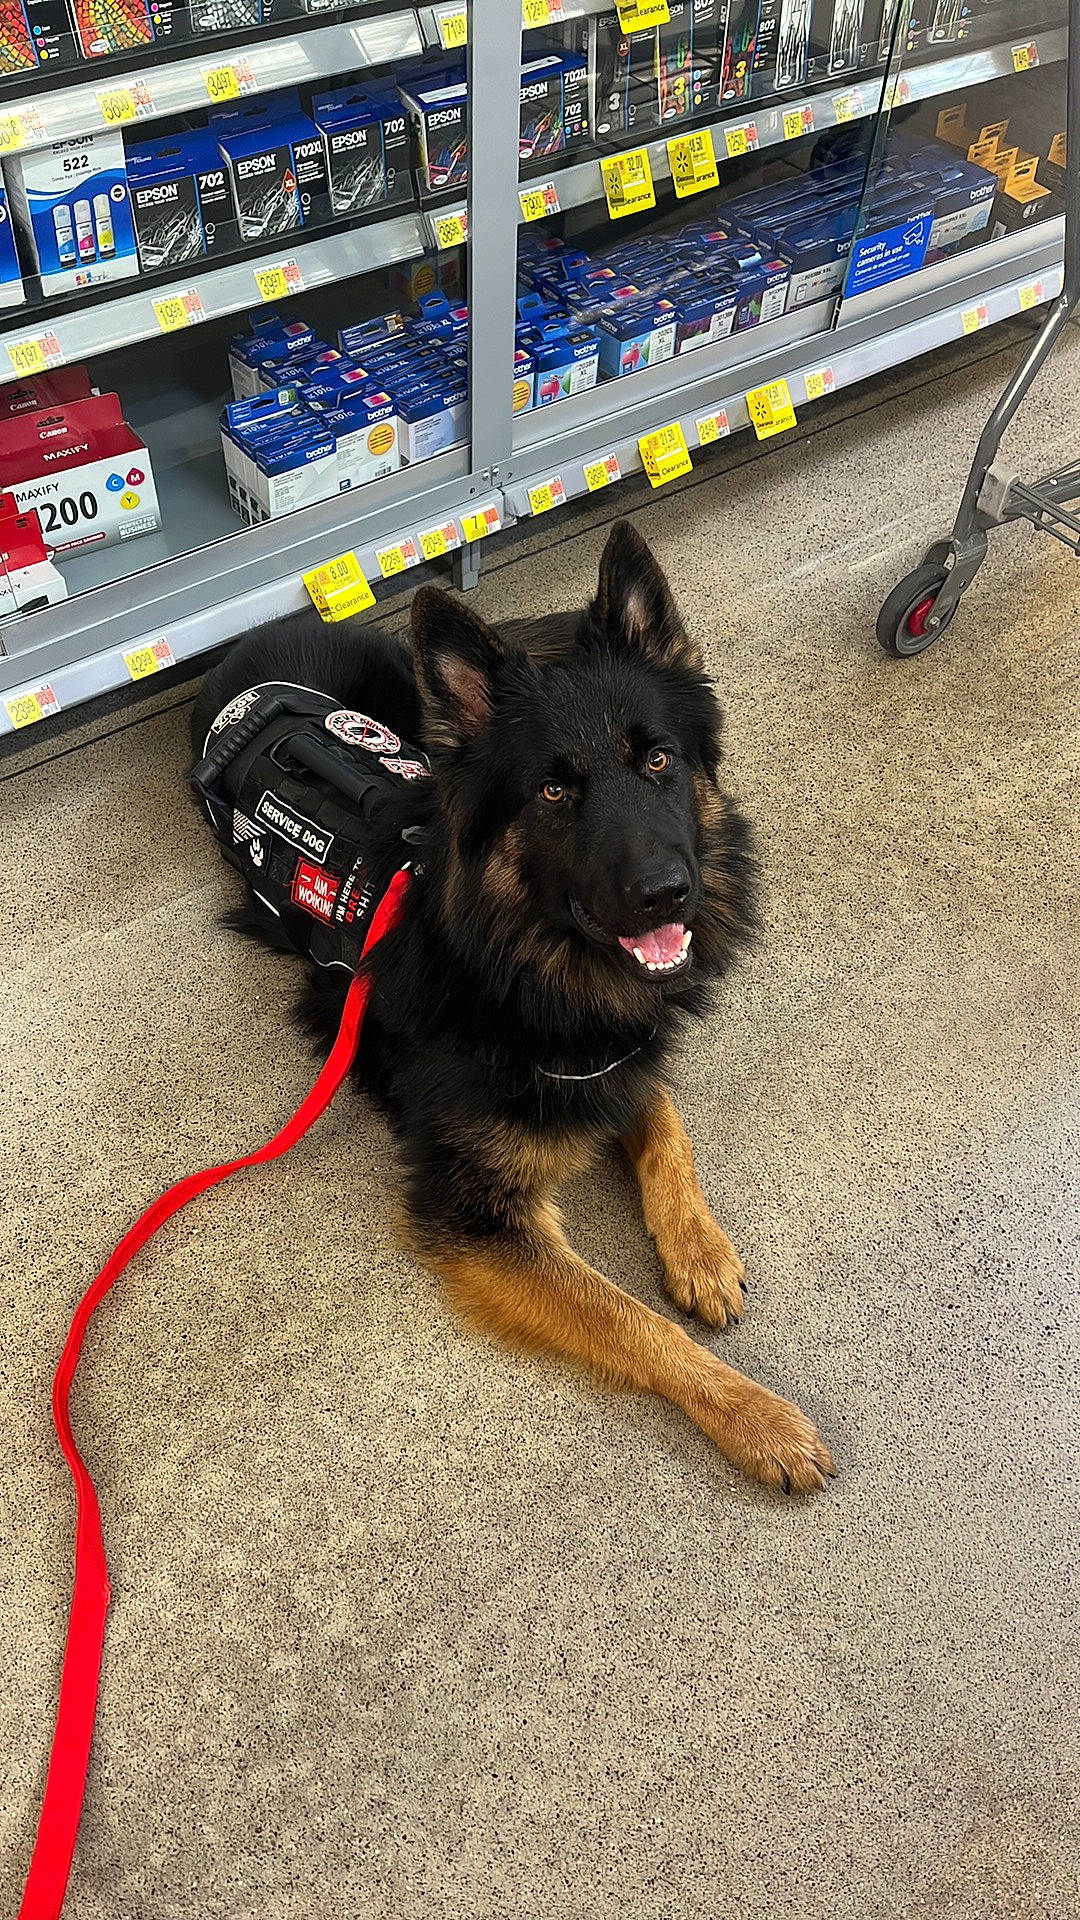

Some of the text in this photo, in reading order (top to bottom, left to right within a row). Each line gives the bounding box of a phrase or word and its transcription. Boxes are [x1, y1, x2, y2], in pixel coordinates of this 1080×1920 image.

[427, 107, 461, 127] EPSON
[565, 103, 581, 117] 702
[384, 118, 405, 135] 702
[331, 130, 366, 149] EPSON
[294, 140, 324, 159] 702XL
[63, 154, 89, 172] 522
[238, 154, 276, 175] EPSON
[199, 172, 225, 189] 702
[137, 184, 178, 204] EPSON
[970, 184, 995, 200] brother
[857, 252, 883, 267] cameras
[892, 246, 903, 255] use
[859, 241, 887, 257] Security
[654, 311, 675, 325] brother
[287, 335, 312, 350] brother
[574, 343, 598, 357] brother
[514, 362, 532, 374] other
[10, 399, 37, 411] Canon
[367, 405, 393, 420] brother
[39, 427, 68, 439] Canon
[43, 443, 89, 461] MAXIFY
[306, 444, 333, 459] brother
[662, 460, 689, 475] Clearance
[131, 473, 141, 482] M
[16, 482, 59, 503] MAXIFY
[120, 521, 157, 536] BUSINESS
[335, 592, 369, 612] Clearance
[261, 801, 325, 853] SERVICE DOG
[340, 874, 356, 903] HERE
[352, 857, 363, 871] TO
[356, 881, 375, 917] SHIT
